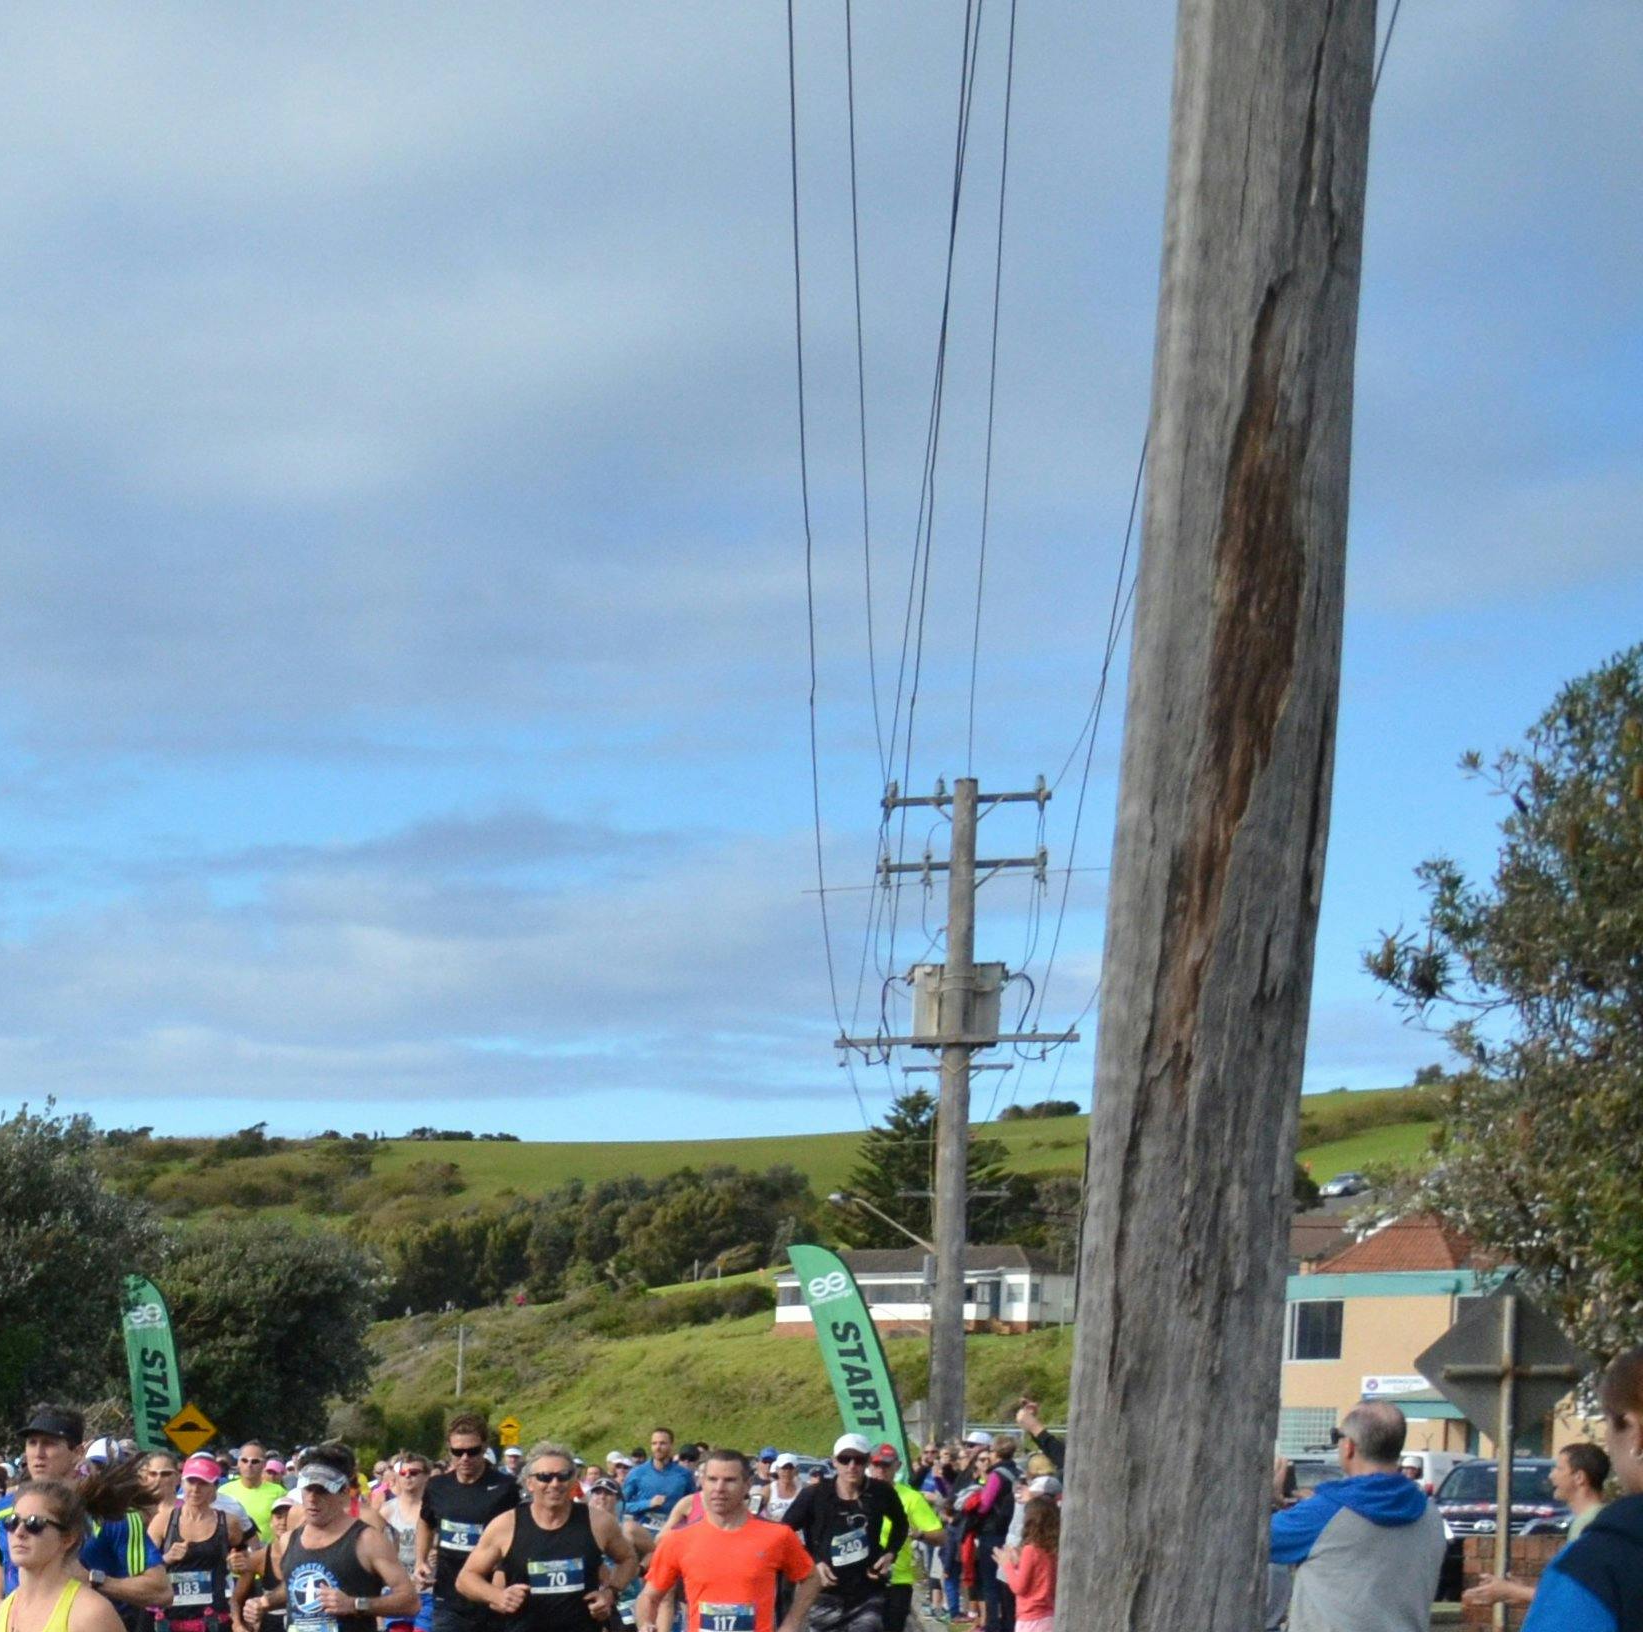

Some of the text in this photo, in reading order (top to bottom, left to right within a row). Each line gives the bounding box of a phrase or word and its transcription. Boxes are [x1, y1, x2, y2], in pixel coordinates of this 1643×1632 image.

[831, 1321, 885, 1432] START
[452, 1532, 468, 1545] 45
[547, 1571, 567, 1587] 70
[178, 1581, 200, 1595] 183
[713, 1616, 737, 1631] 117
